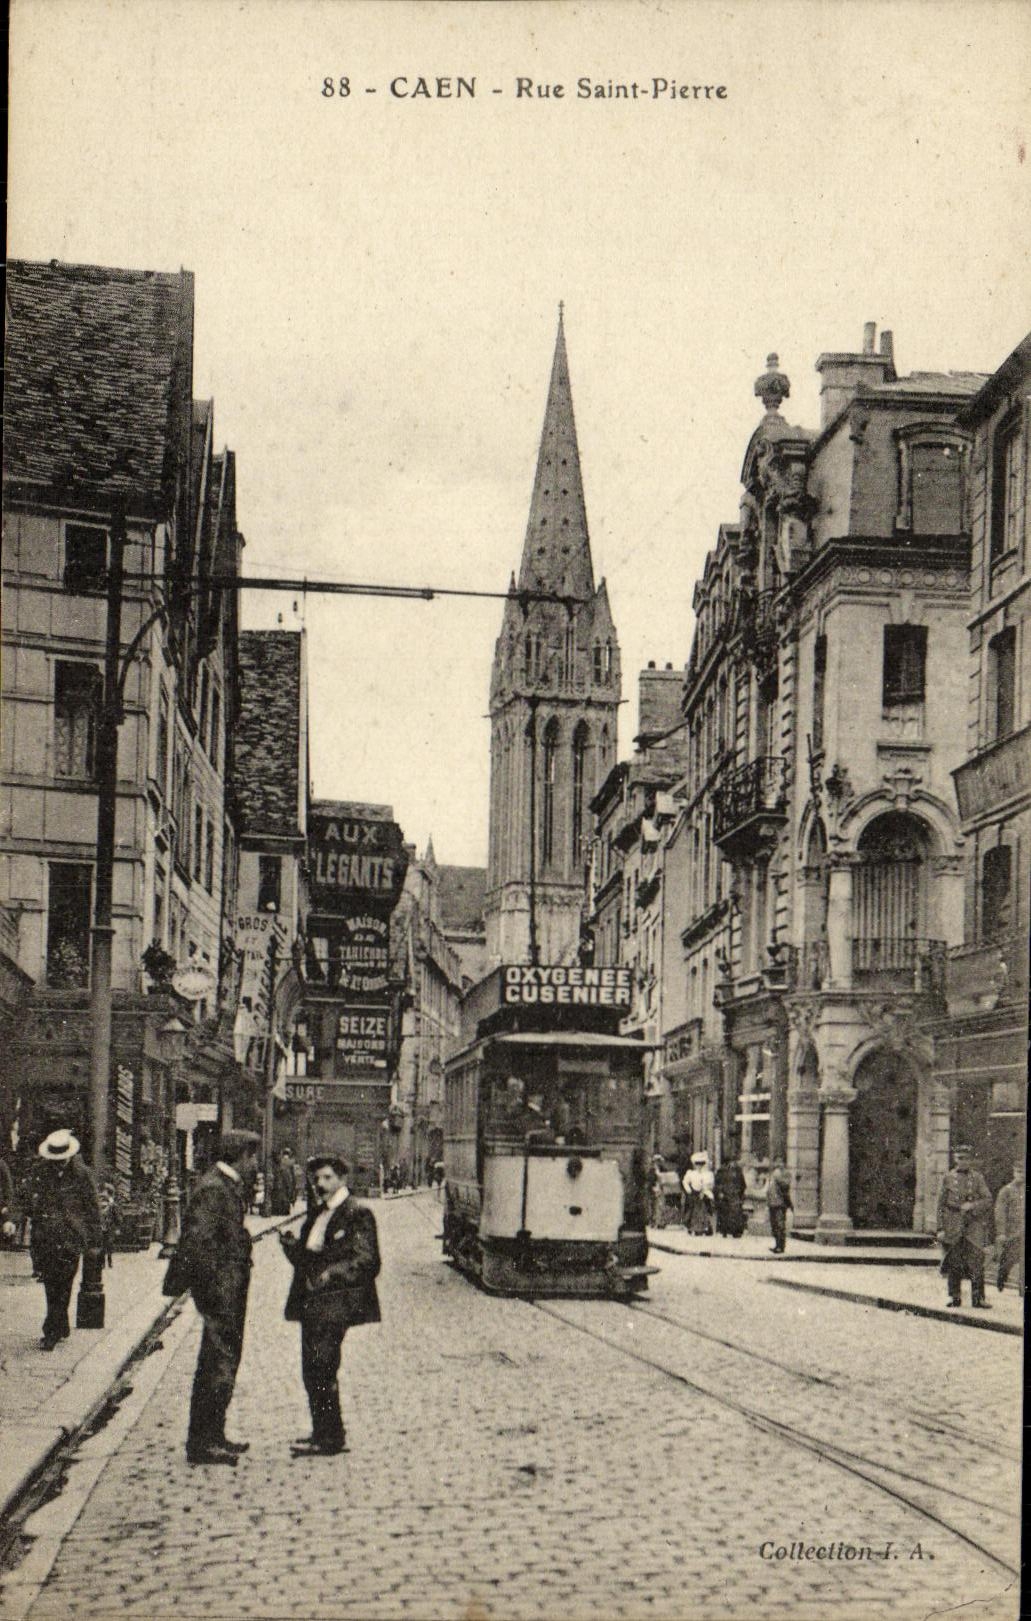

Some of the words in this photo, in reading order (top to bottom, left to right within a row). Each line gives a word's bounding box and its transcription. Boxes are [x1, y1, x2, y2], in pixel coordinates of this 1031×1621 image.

[324, 822, 379, 844] AUX
[238, 916, 269, 932] GROS
[504, 985, 631, 1005] CUSENIER
[339, 1015, 387, 1036] SEIZE
